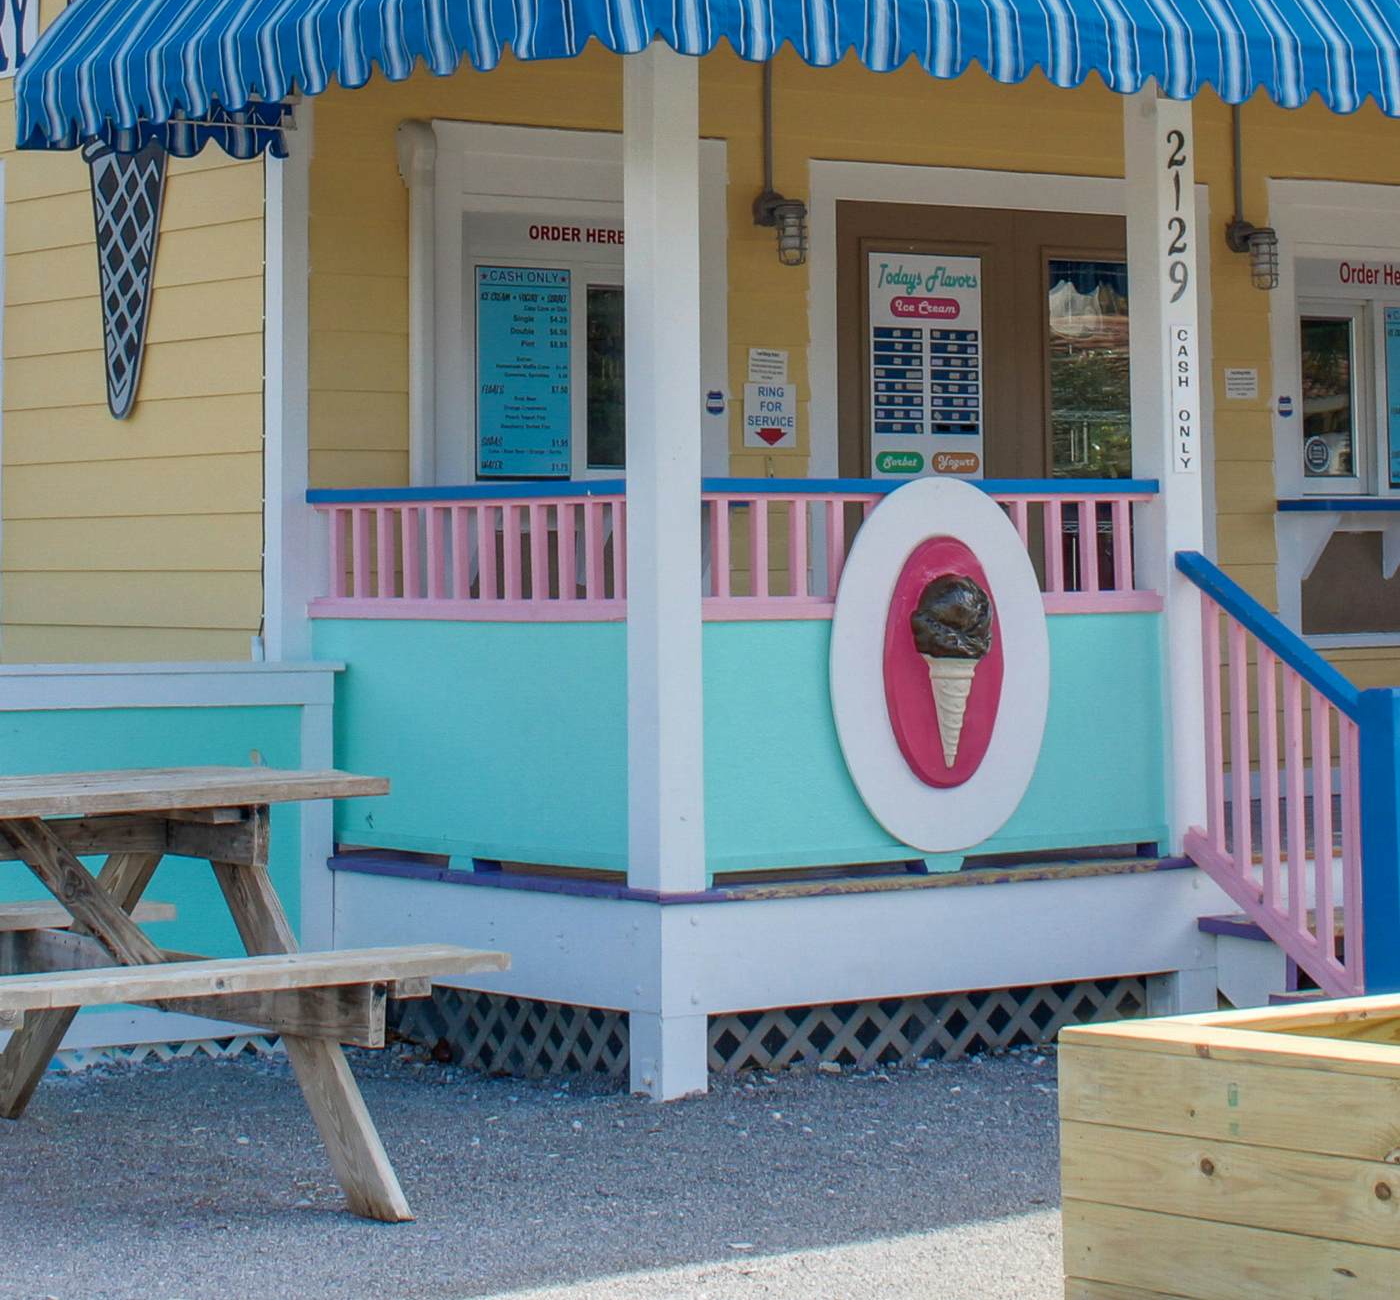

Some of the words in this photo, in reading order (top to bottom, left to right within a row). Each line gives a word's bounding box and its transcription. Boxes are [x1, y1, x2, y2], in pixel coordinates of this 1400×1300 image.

[1166, 129, 1188, 304] 2129
[529, 225, 581, 242] ORDER
[586, 228, 624, 245] HERE
[489, 270, 523, 282] CASH
[527, 272, 559, 284] ONLY
[925, 266, 978, 293] Flavors
[1340, 262, 1379, 285] Order
[895, 300, 915, 312] Ice
[919, 301, 956, 315] Cream
[1177, 329, 1189, 388] CASH
[758, 386, 785, 398] RING
[760, 401, 782, 413] FOR
[748, 415, 794, 428] SERVICE
[1178, 409, 1192, 469] ONLY
[883, 455, 918, 469] Sorbet
[938, 455, 976, 470] Yogurt
